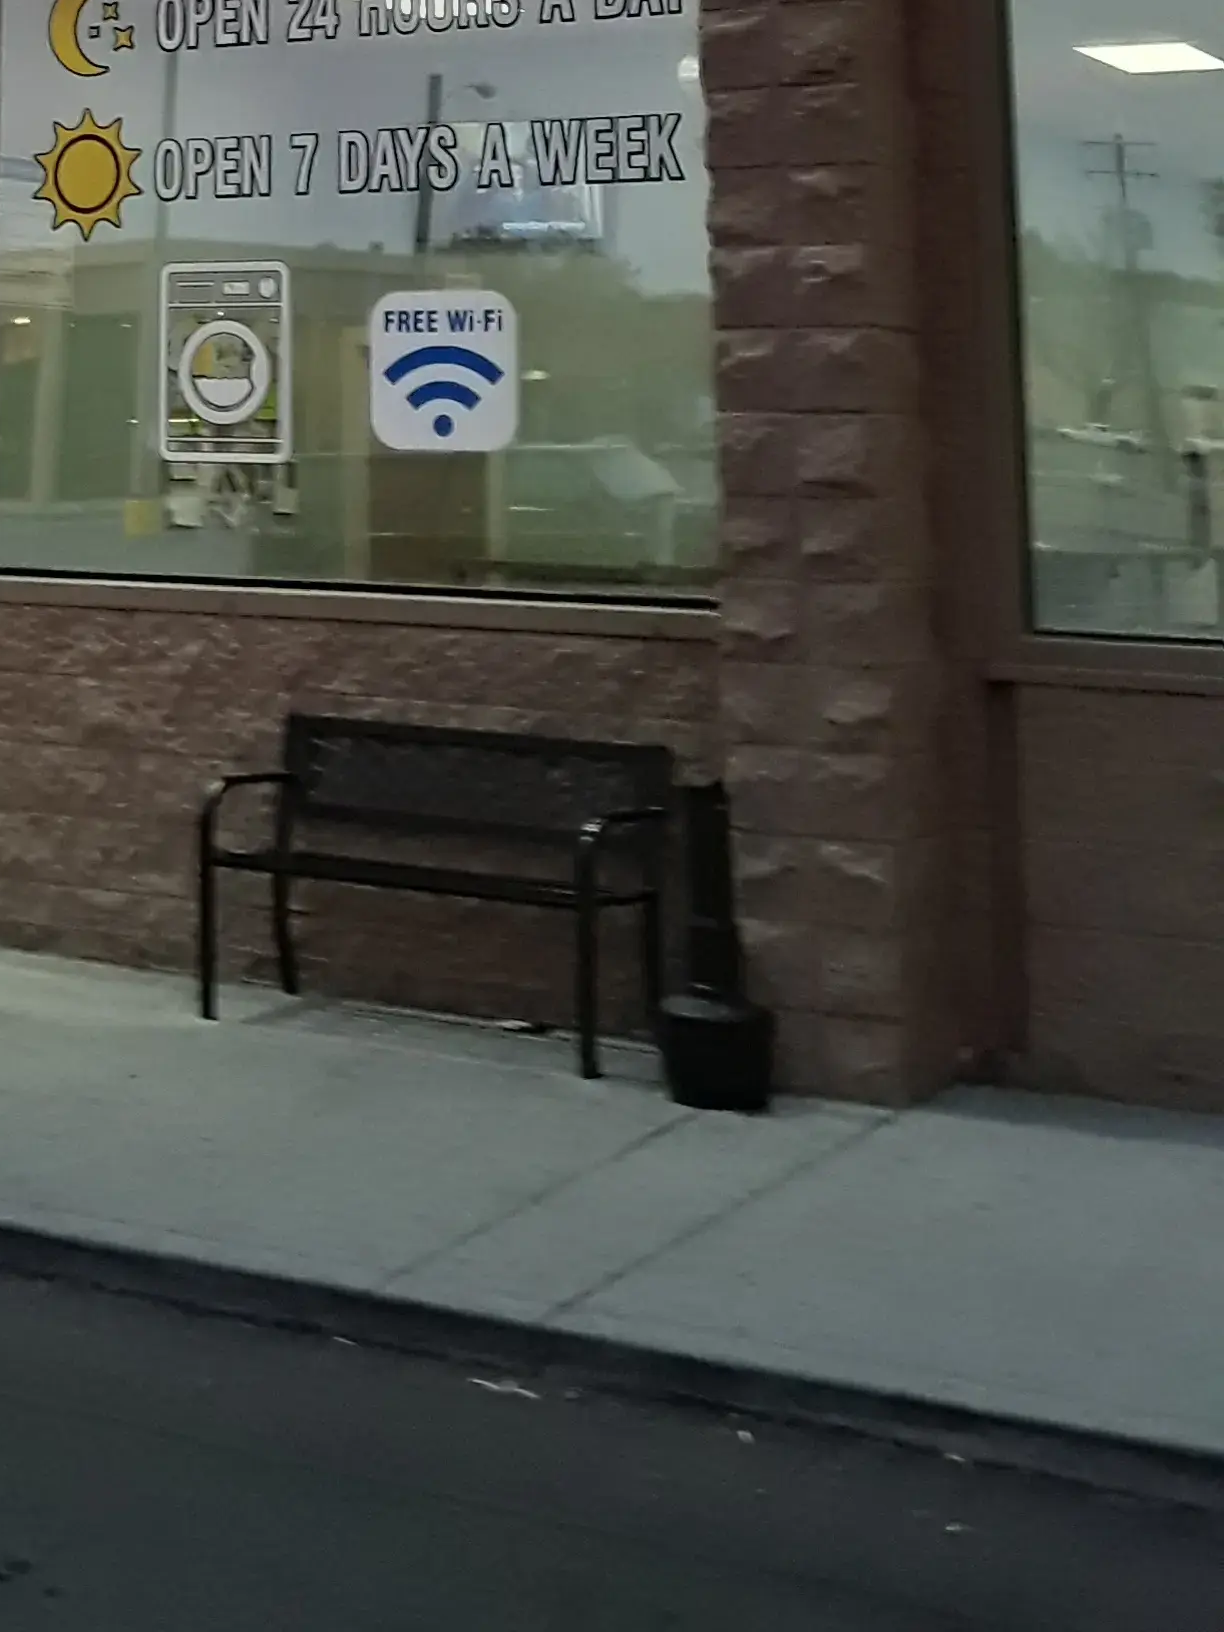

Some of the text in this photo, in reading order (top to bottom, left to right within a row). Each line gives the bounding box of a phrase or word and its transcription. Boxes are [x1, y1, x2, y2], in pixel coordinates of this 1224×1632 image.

[153, 113, 686, 201] OPEN 7 DAYS A WEEK
[384, 309, 503, 333] FREE Wi-Fi
